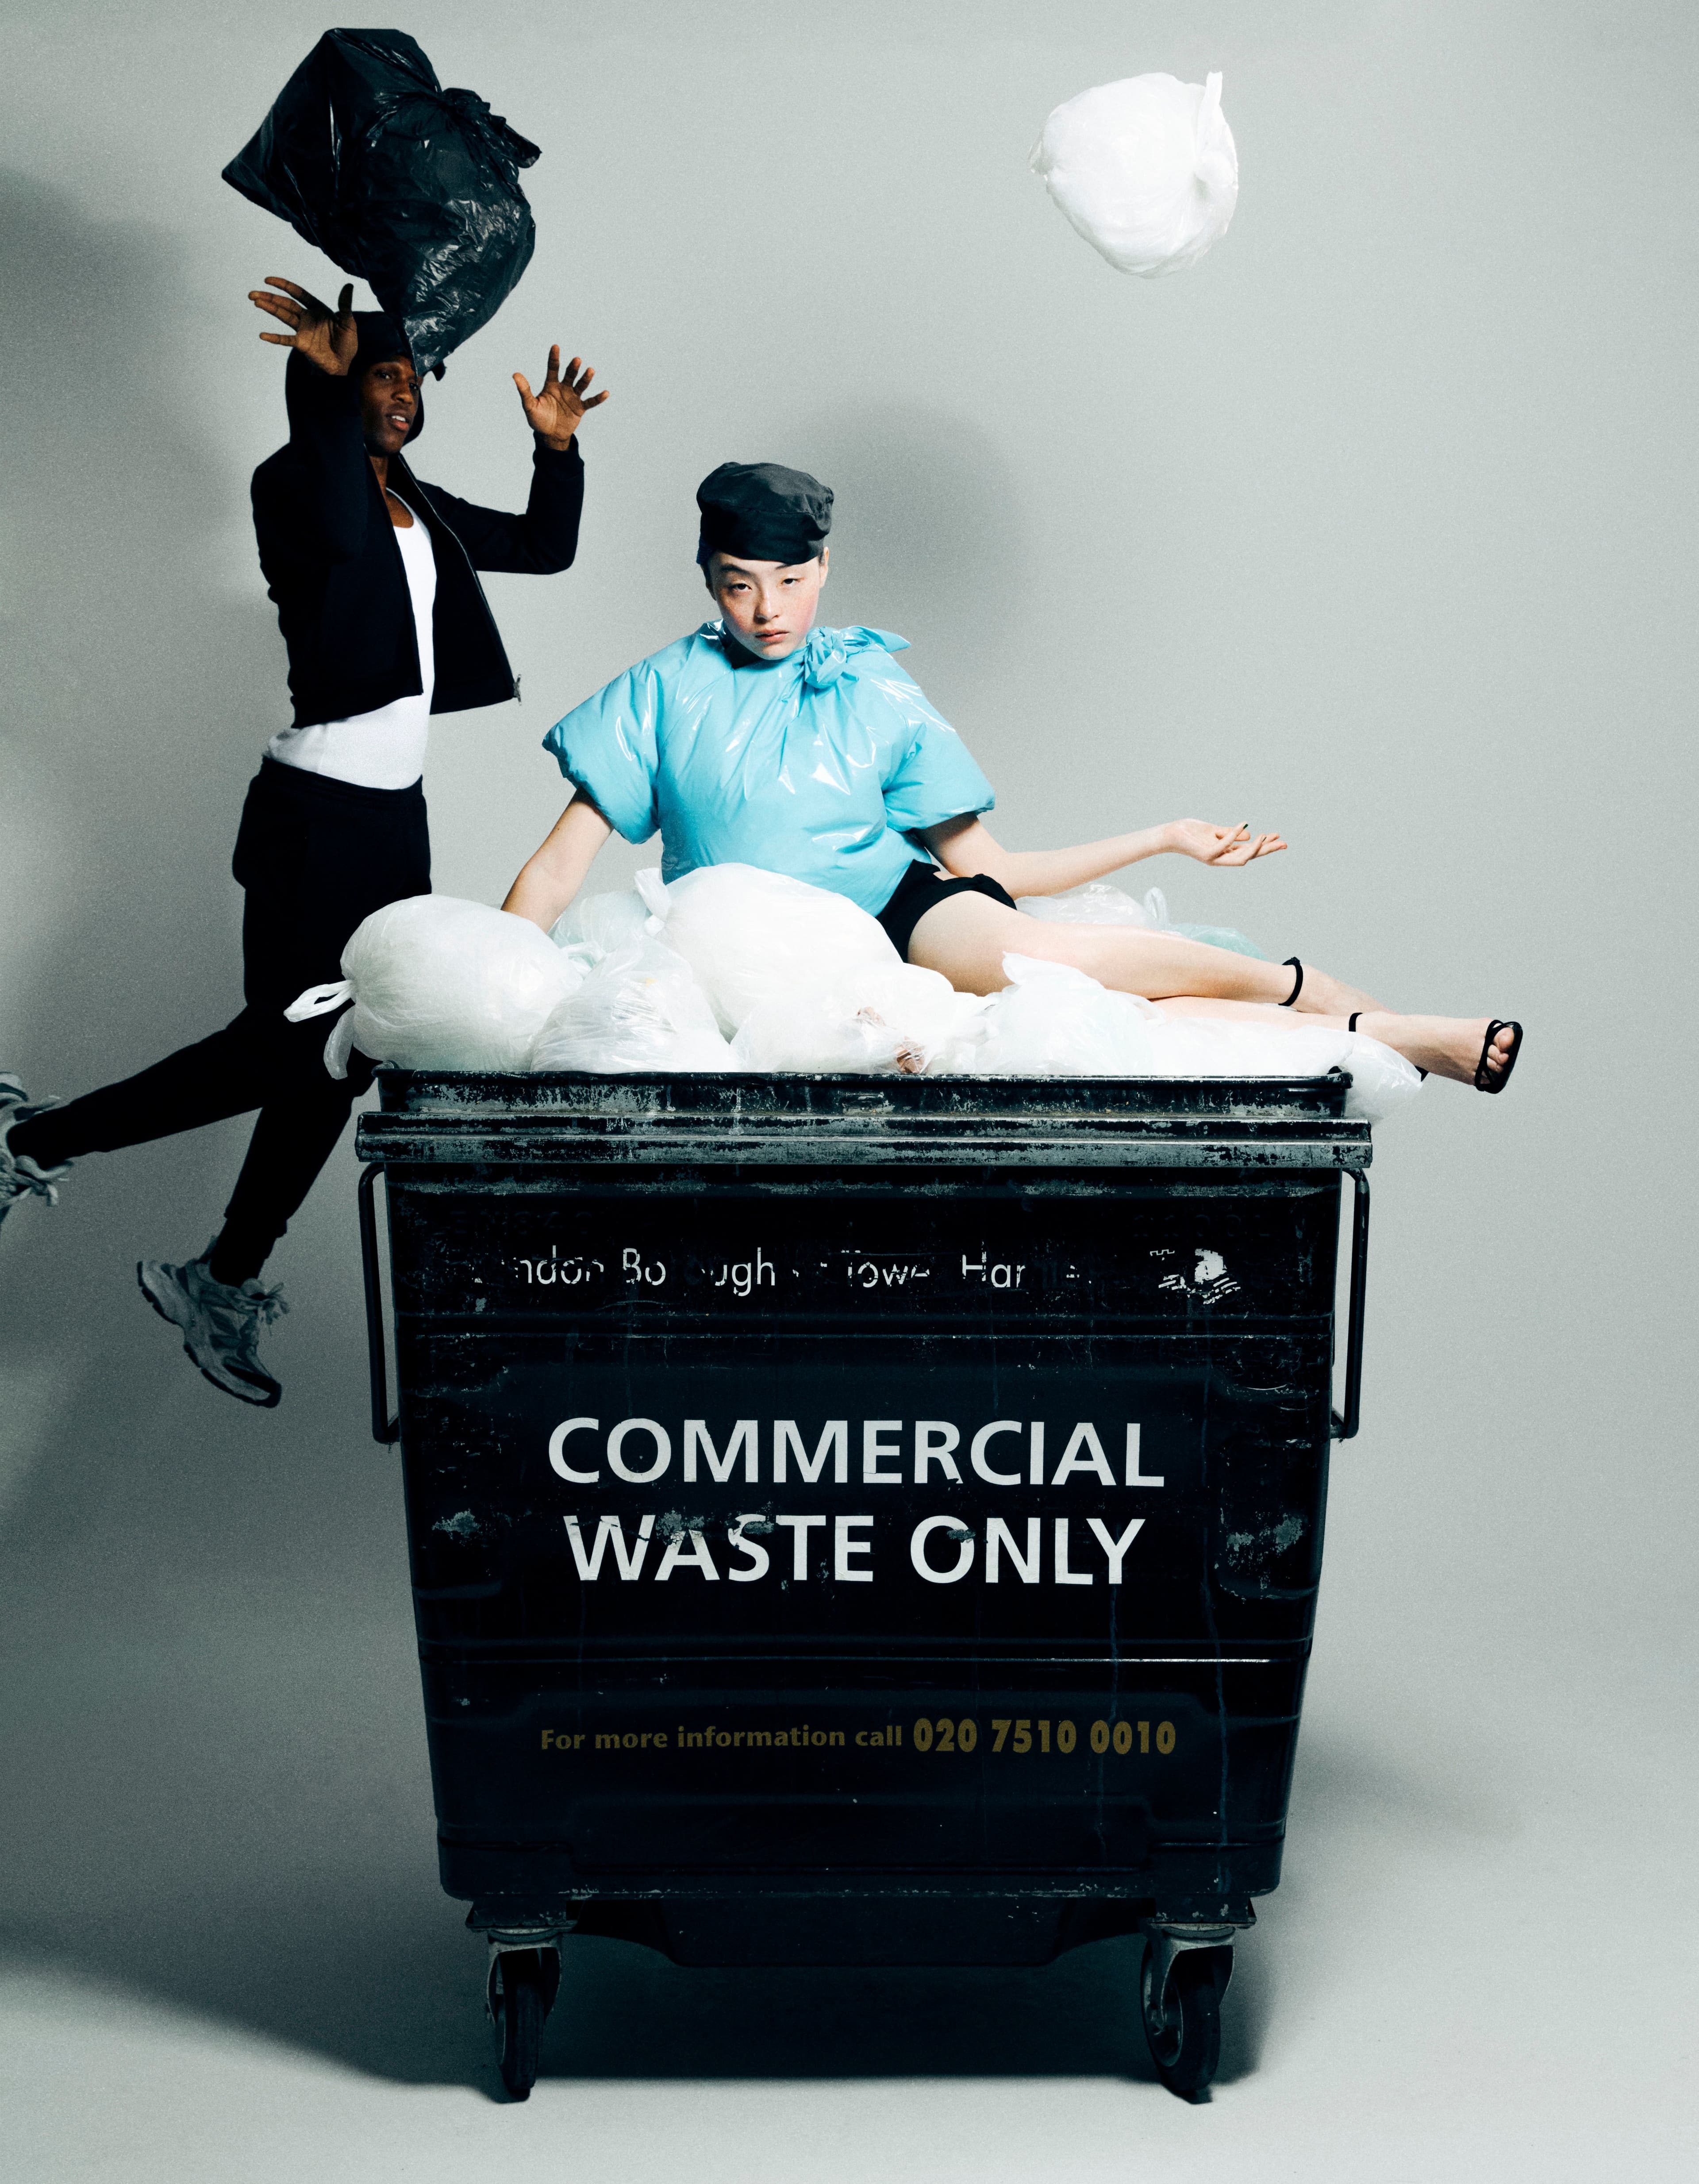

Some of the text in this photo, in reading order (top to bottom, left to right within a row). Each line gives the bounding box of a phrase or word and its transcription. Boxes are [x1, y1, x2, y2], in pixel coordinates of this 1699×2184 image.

[549, 1417, 1164, 1487] COMMERCIAL
[564, 1514, 1145, 1584] WASTE ONLY
[542, 1718, 1176, 1754] For more information call 020 7510 0010
